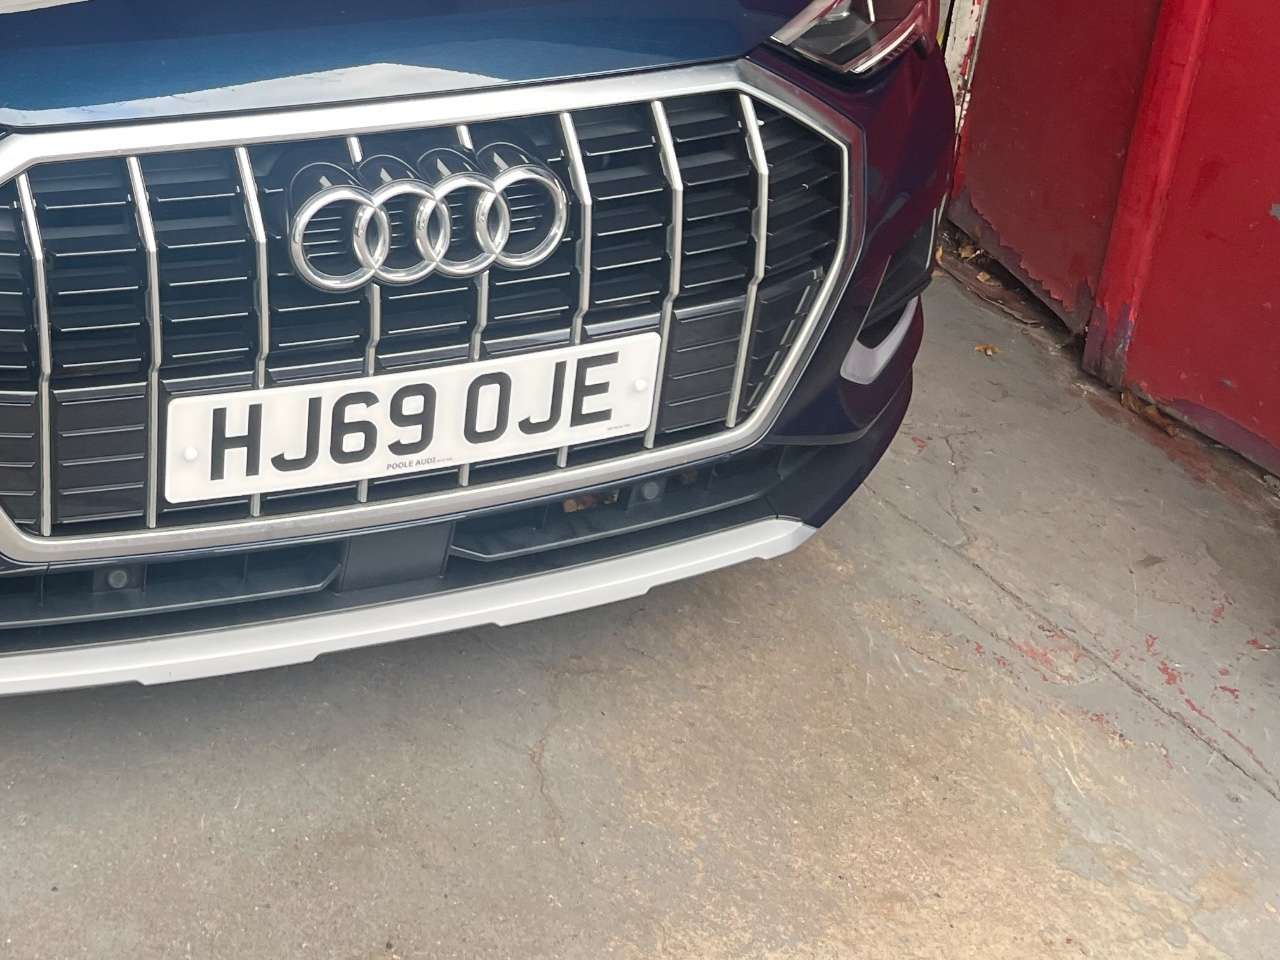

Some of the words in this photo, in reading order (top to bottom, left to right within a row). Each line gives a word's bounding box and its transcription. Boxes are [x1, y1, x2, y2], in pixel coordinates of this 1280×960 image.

[210, 383, 437, 481] HJ69
[463, 351, 620, 444] OJE
[386, 460, 414, 470] POOLE
[415, 456, 436, 466] AUDI
